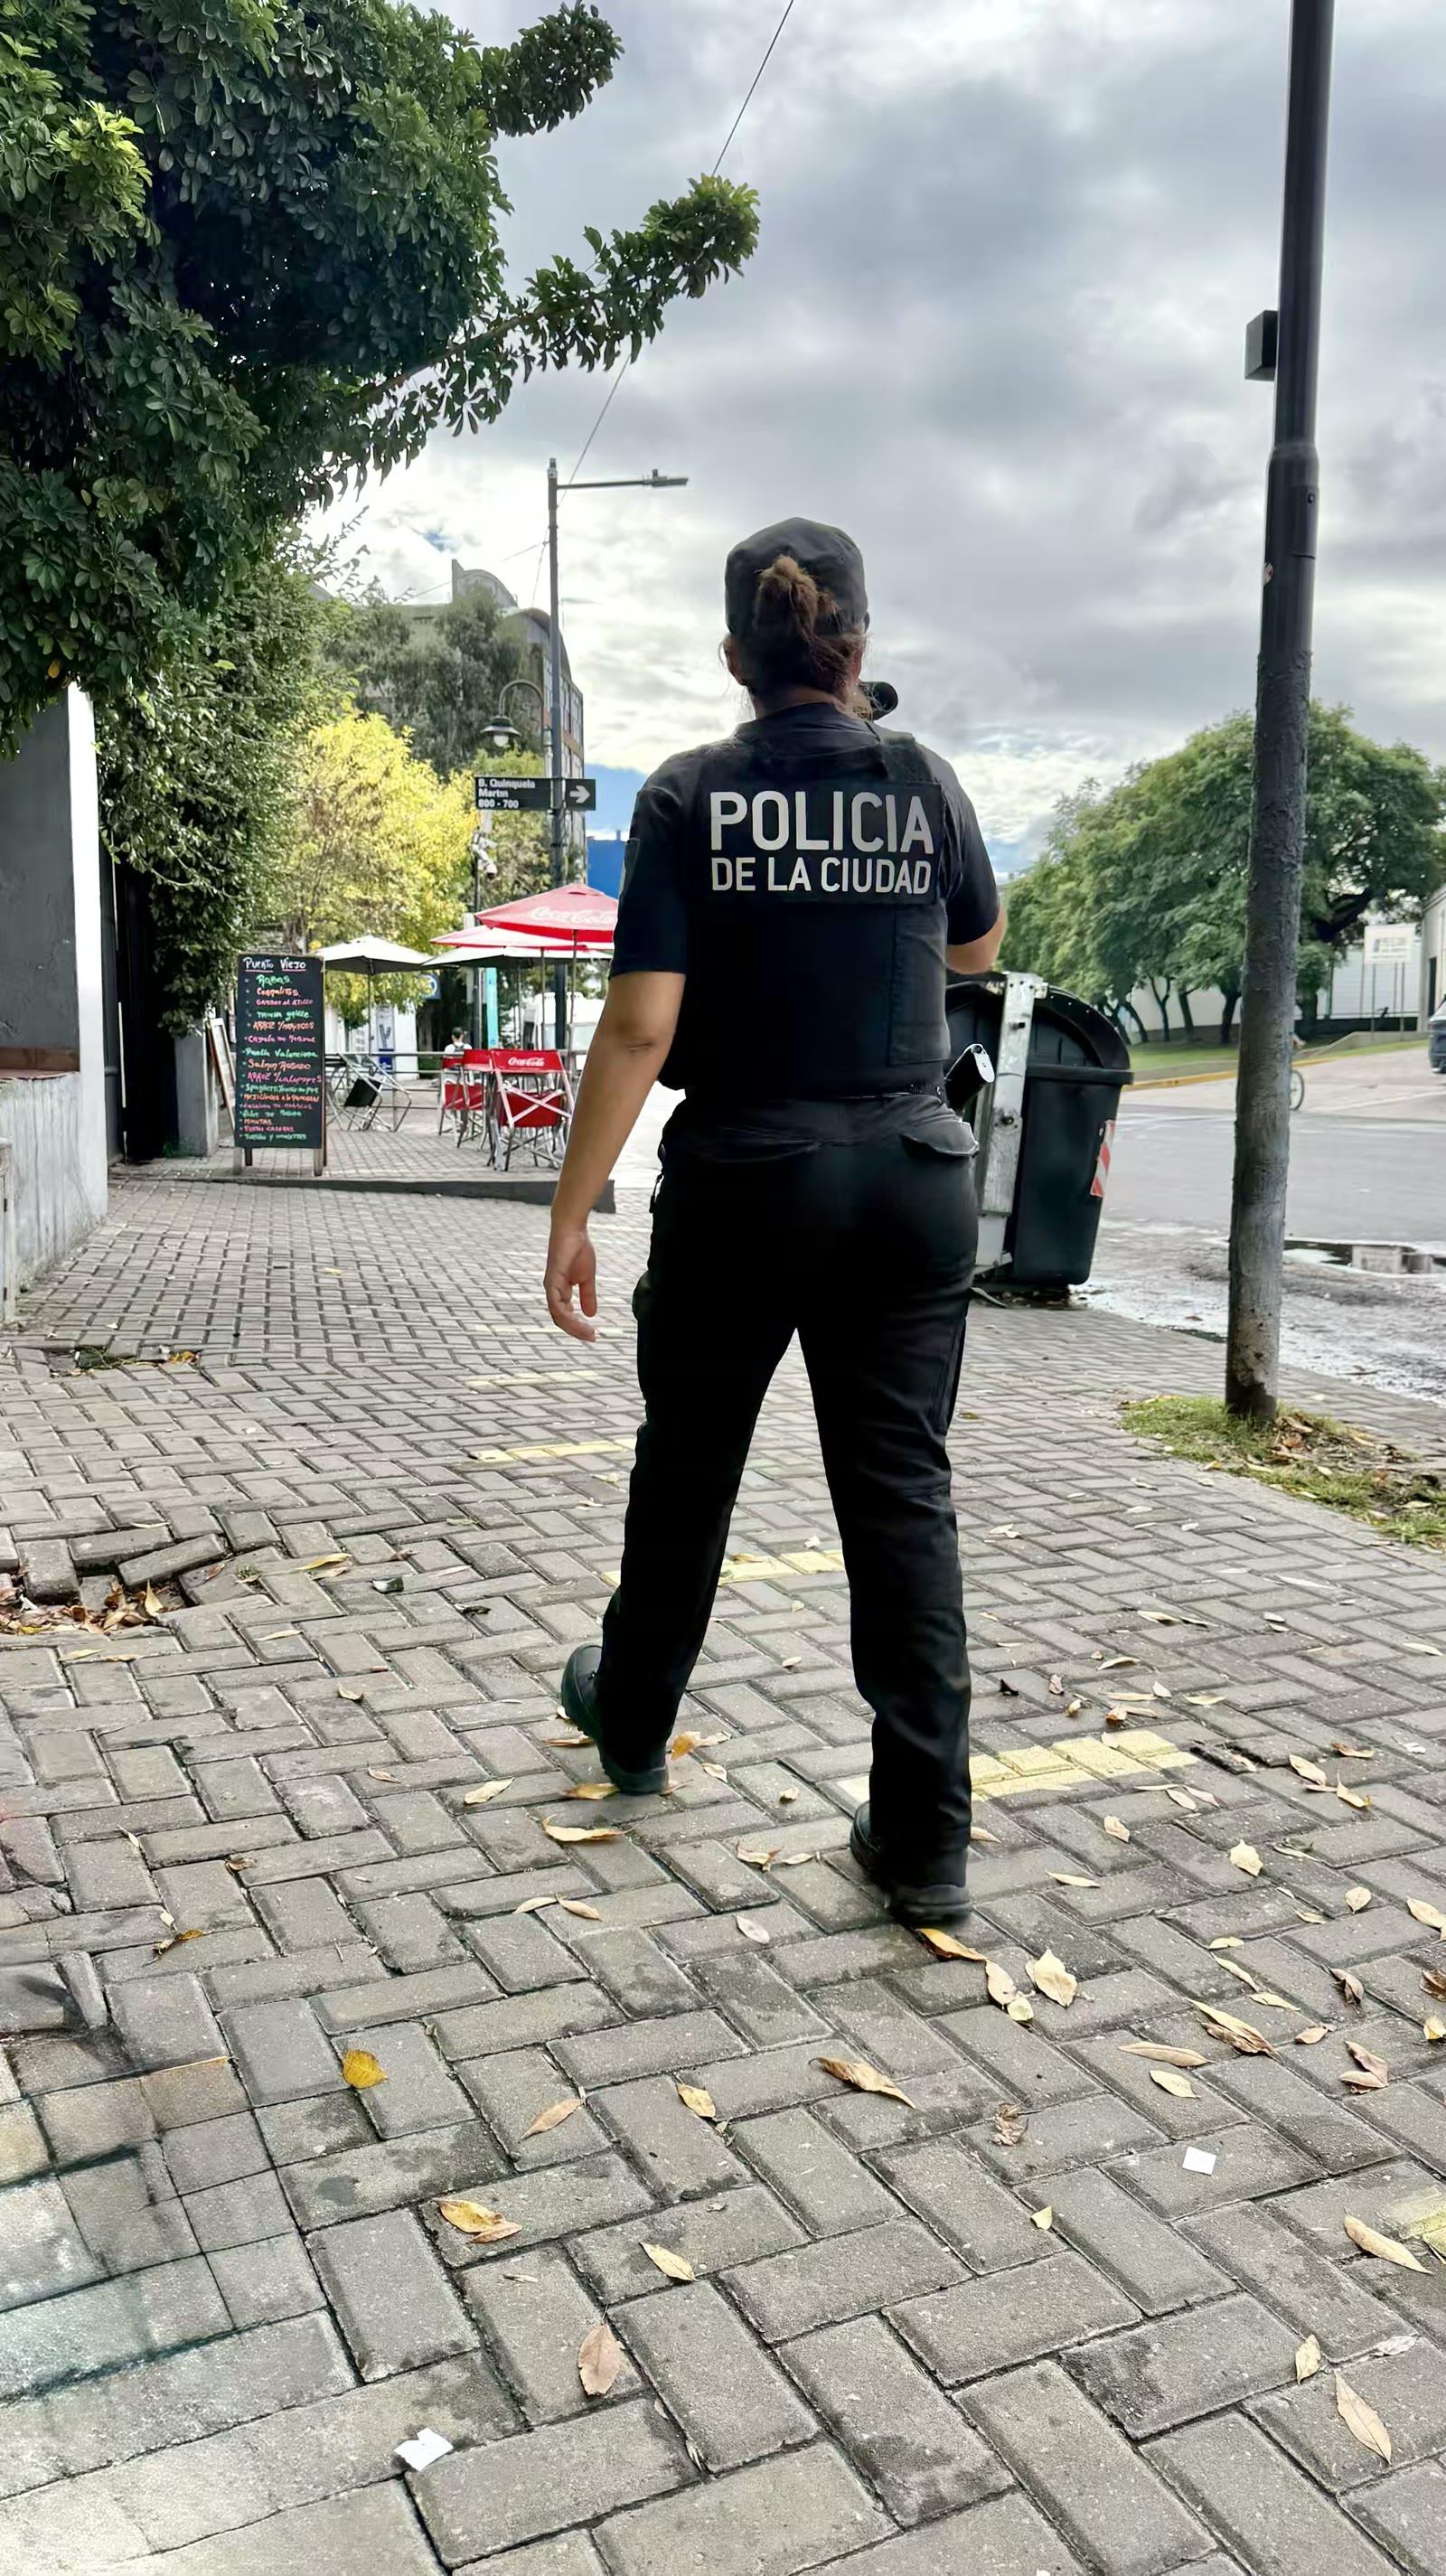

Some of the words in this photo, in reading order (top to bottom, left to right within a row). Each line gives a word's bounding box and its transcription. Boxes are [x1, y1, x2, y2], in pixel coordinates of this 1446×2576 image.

[478, 778, 488, 787] B.
[490, 778, 536, 790] Quinquela
[478, 799, 495, 809] 800
[503, 799, 519, 809] 700
[709, 790, 934, 855] POLICIA
[711, 857, 756, 892] DE
[767, 856, 812, 892] LA
[821, 857, 932, 895] CIUDAD
[508, 1057, 545, 1067] Coca-Cola
